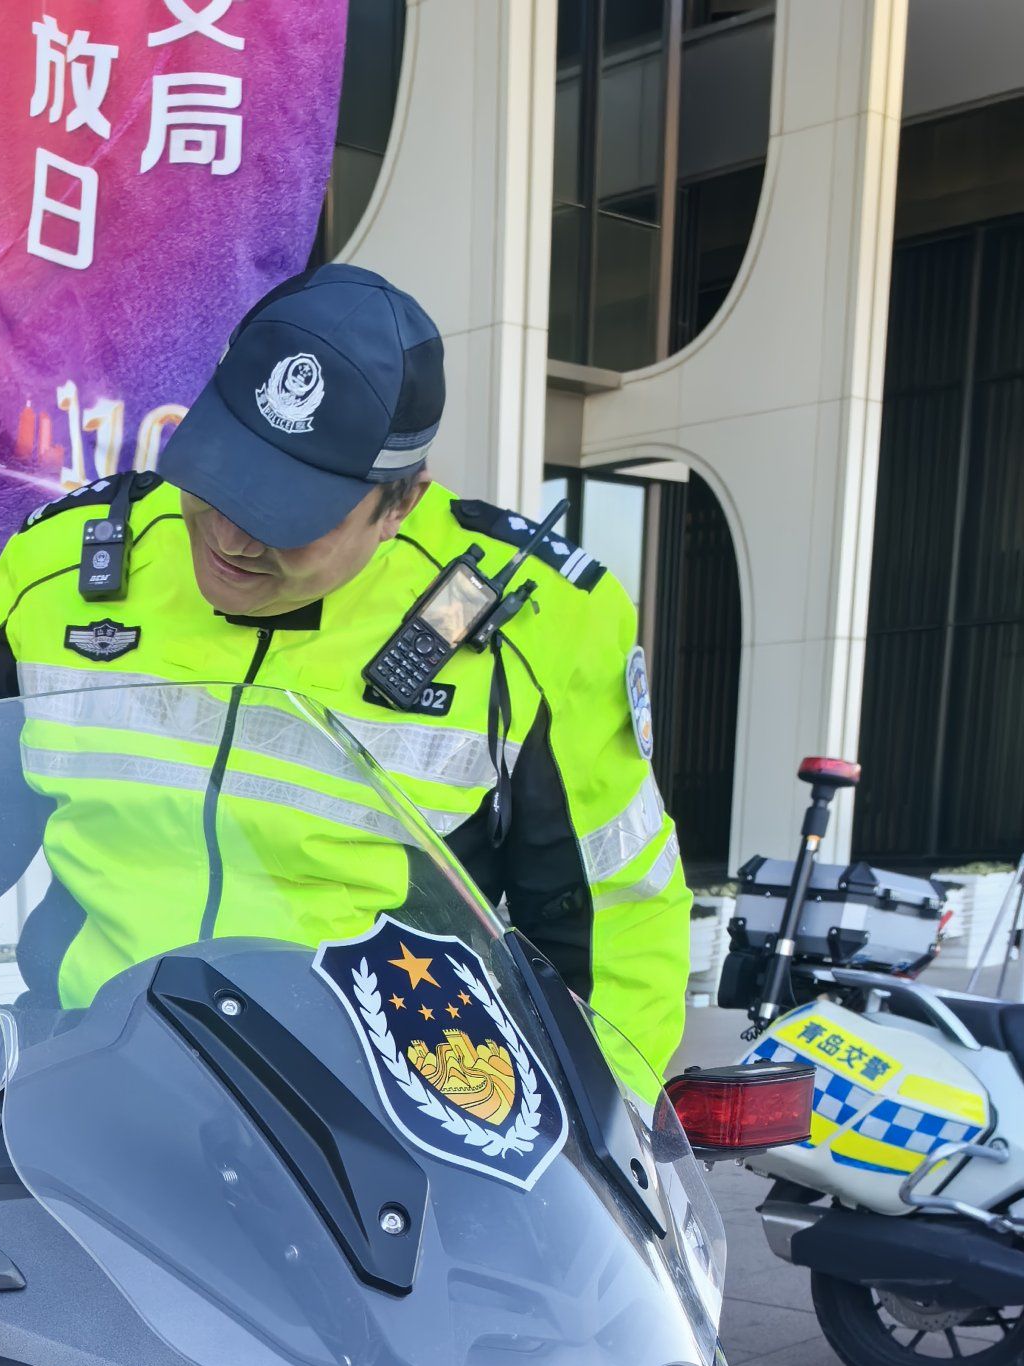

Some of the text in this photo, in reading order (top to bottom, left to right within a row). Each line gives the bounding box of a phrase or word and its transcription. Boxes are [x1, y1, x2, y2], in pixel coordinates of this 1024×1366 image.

[27, 14, 120, 270] 放日
[264, 405, 293, 431] POLICE
[797, 1021, 891, 1081] 青岛交警
